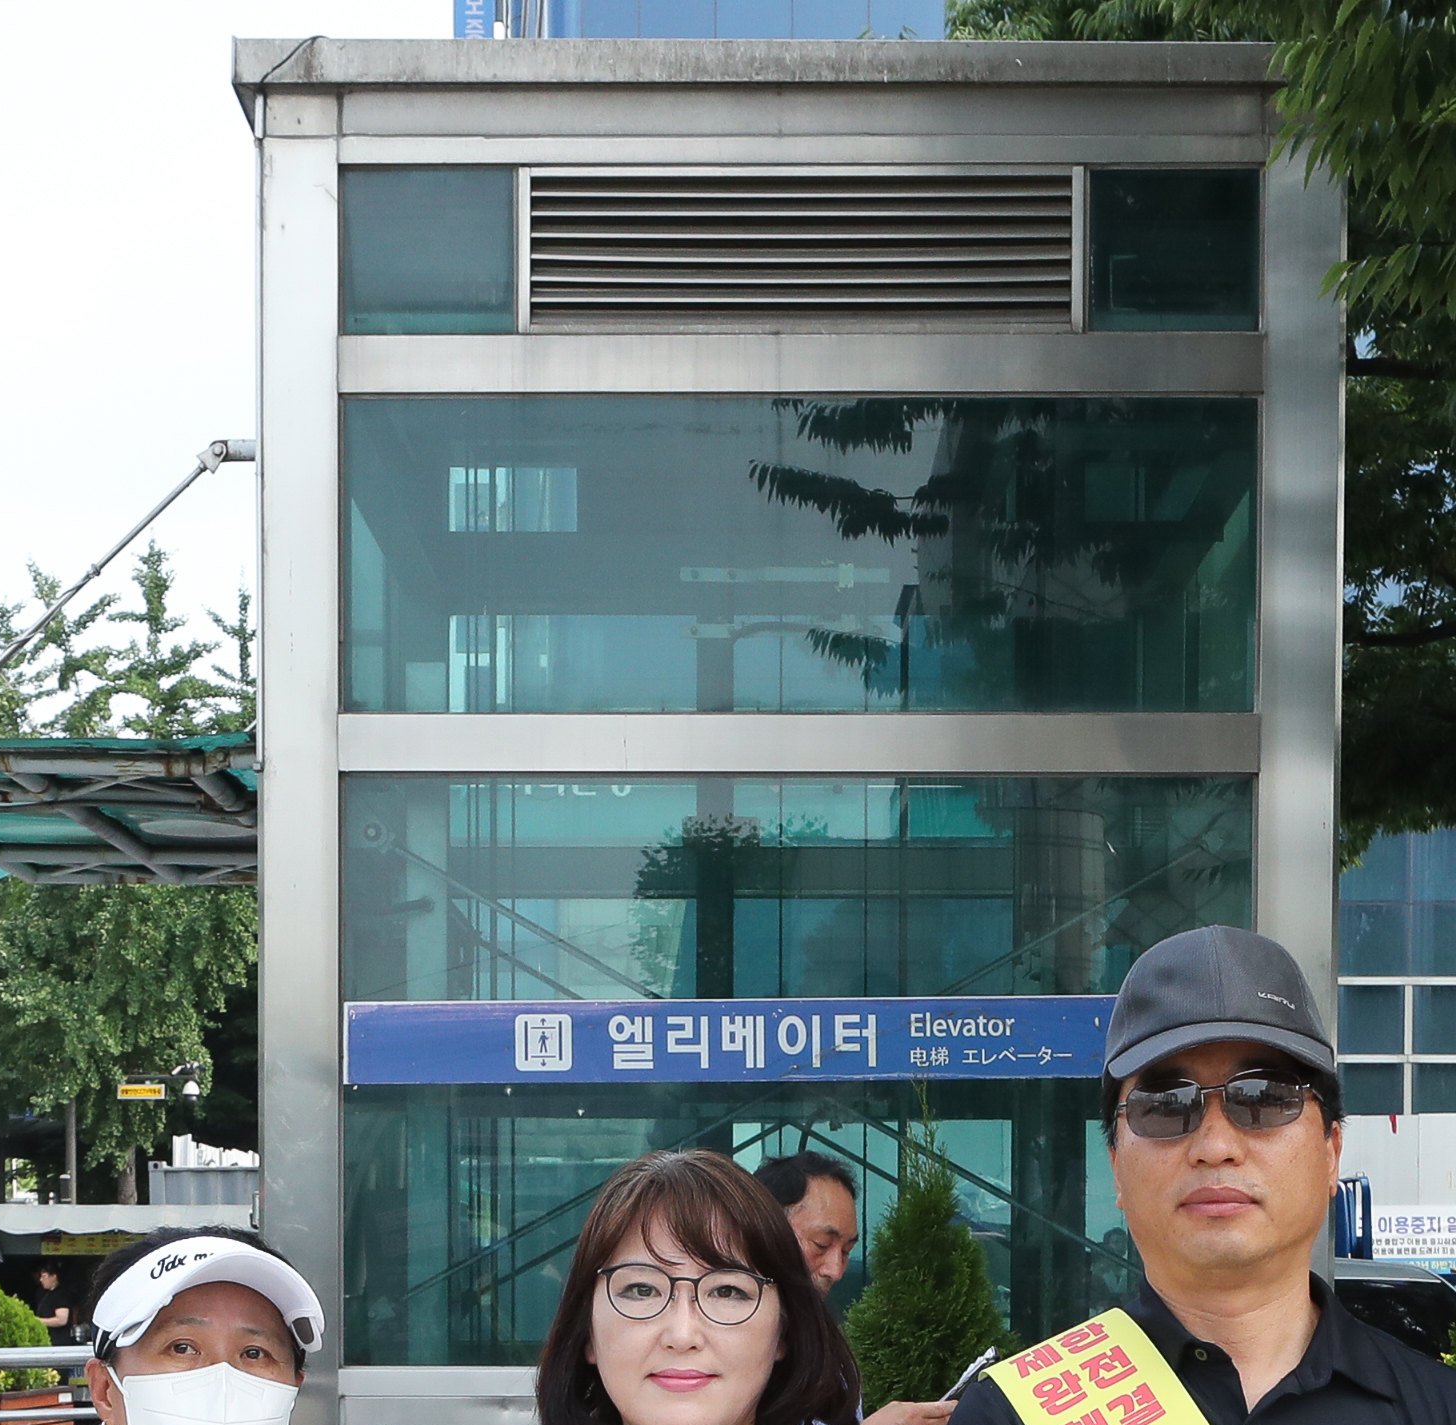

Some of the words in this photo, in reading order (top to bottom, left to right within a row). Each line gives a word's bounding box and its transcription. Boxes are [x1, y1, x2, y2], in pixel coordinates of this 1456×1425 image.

[910, 1012, 1015, 1040] Elevator
[609, 1012, 877, 1071] 엘리베이터
[910, 1045, 950, 1067] 电梯
[961, 1046, 1073, 1067] エレベーター
[1378, 1216, 1441, 1234] 이용중지
[1008, 1322, 1110, 1379] 제한
[1033, 1345, 1138, 1415] 완전
